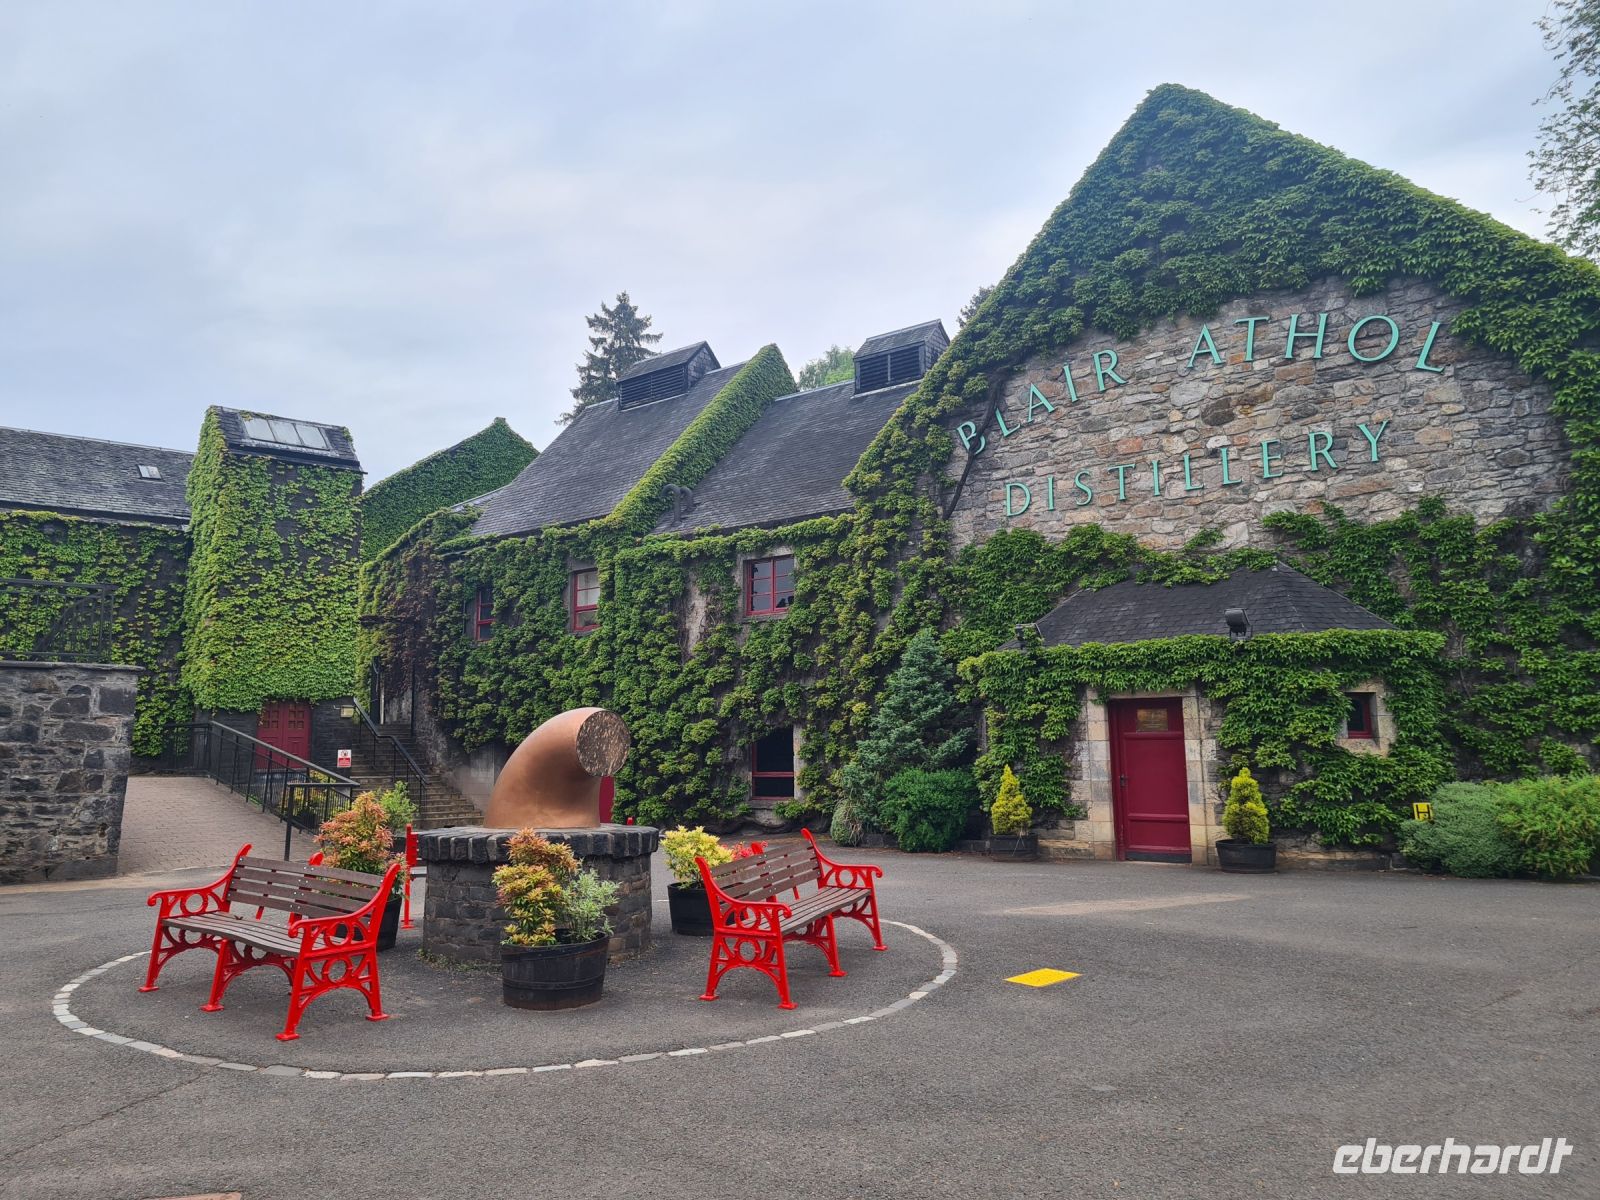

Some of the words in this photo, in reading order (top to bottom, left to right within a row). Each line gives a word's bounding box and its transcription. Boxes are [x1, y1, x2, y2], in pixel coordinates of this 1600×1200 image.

[956, 349, 1127, 455] BLAIR
[1187, 312, 1446, 374] ATHOL
[1004, 420, 1391, 517] DISTILLERY
